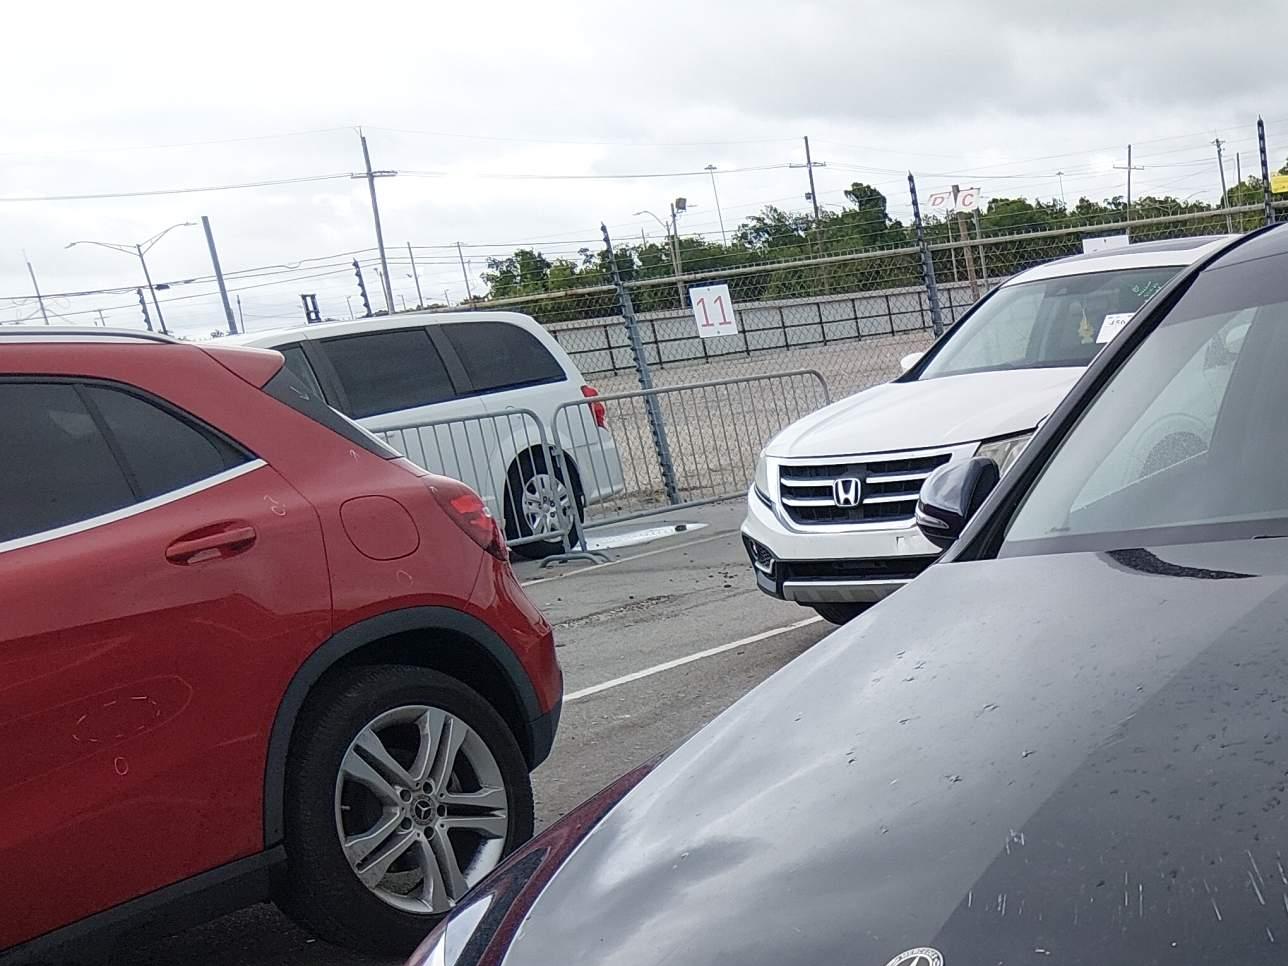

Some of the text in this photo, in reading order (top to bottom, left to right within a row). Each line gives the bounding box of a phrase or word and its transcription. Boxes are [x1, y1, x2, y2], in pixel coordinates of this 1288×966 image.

[931, 196, 945, 207] D
[961, 193, 974, 207] C
[696, 295, 732, 327] 11
